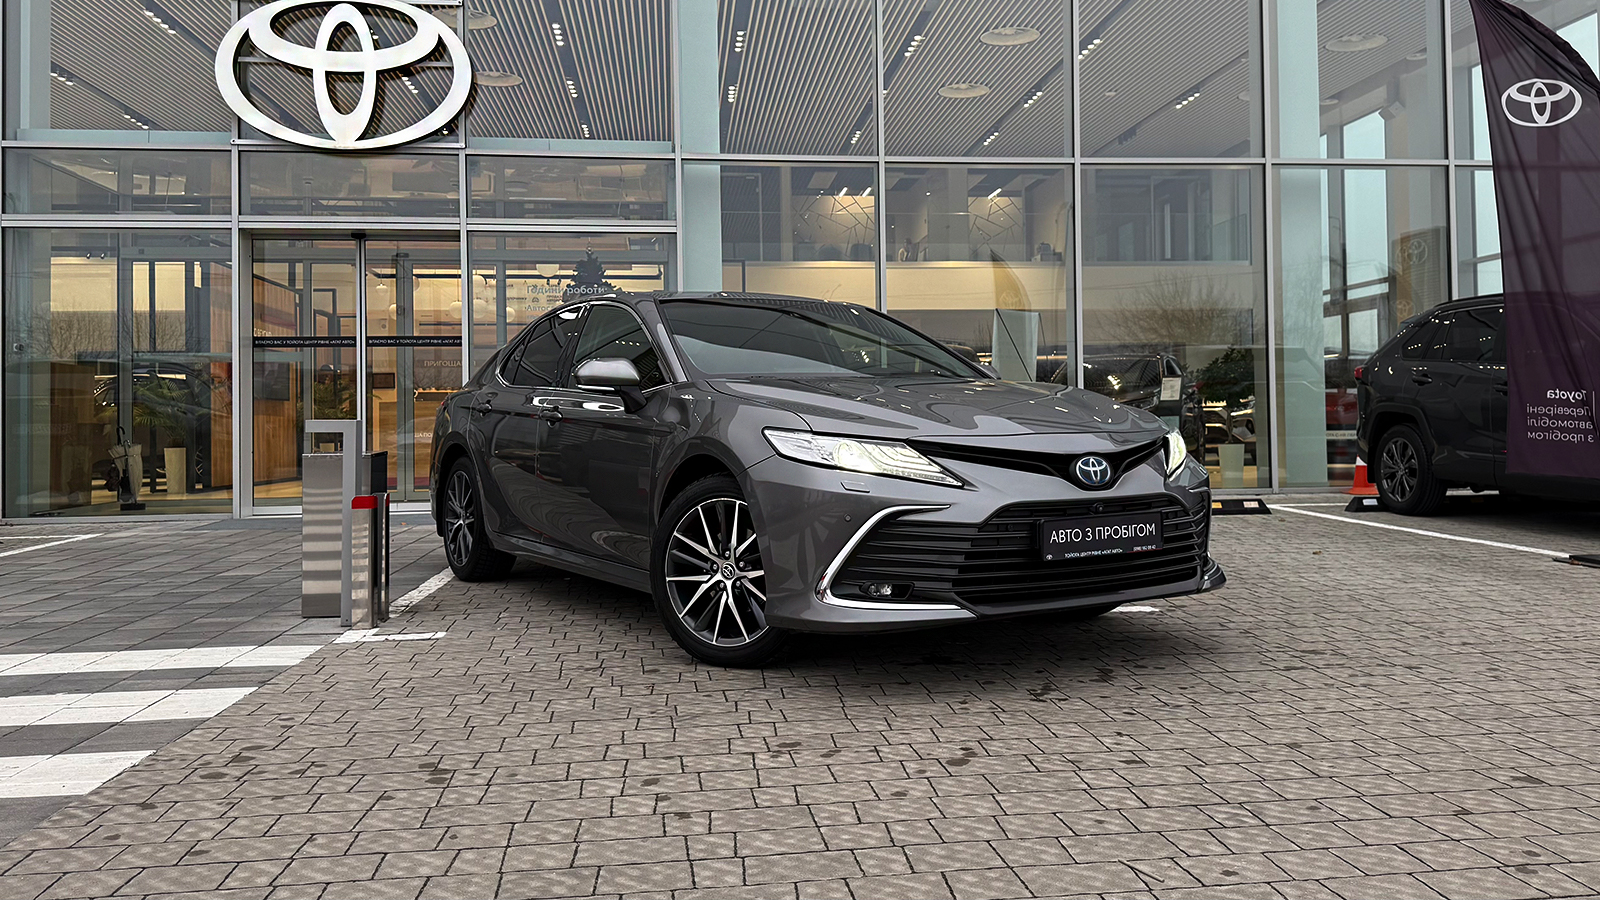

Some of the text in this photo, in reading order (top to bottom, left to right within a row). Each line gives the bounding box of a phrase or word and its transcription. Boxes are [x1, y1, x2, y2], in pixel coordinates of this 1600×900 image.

[527, 285, 564, 294] Години
[1049, 529, 1082, 544] АВТО
[1095, 523, 1156, 540] ПРОБІГОМ
